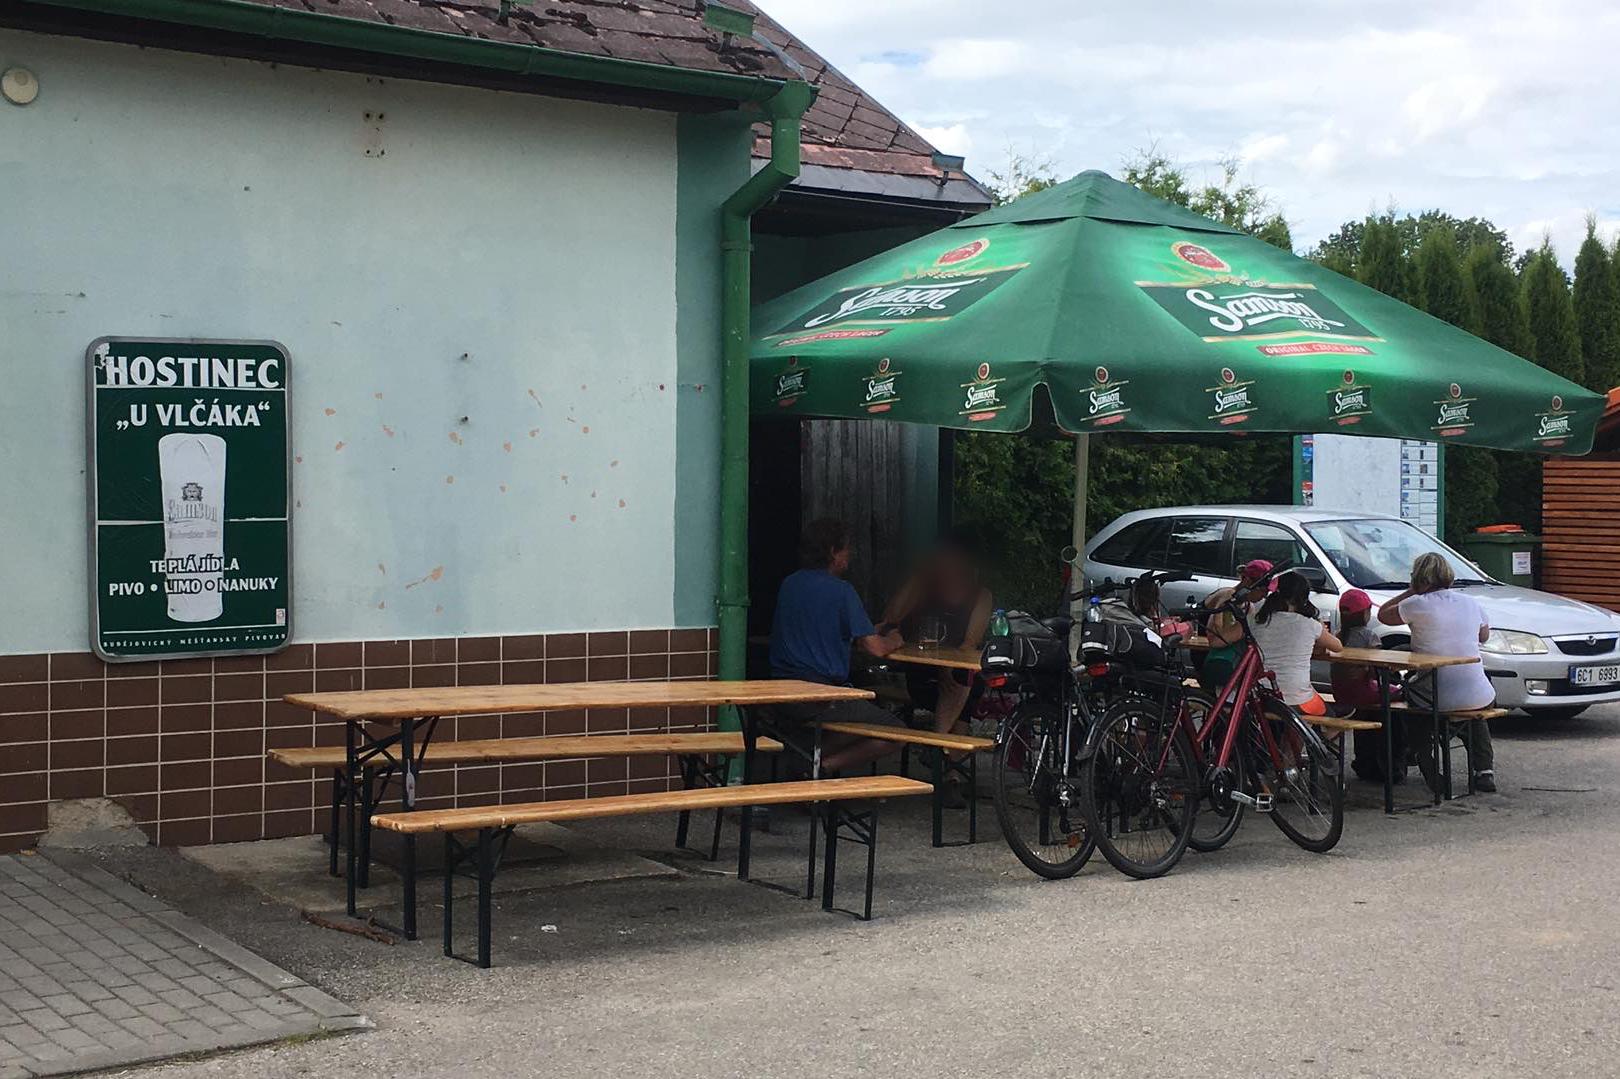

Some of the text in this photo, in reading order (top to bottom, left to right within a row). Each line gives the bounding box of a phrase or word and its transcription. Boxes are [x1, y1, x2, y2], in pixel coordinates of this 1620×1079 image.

[1186, 289, 1345, 332] Samson
[1299, 318, 1331, 331] 1795
[105, 356, 279, 388] HOSTINEC
[866, 378, 896, 401] Samson
[965, 384, 999, 409] Samson
[1089, 387, 1124, 414] Samson
[1215, 387, 1252, 413] Samson
[1335, 390, 1366, 414] Samson
[1438, 404, 1469, 425] Samson
[1538, 416, 1571, 437] Samson
[150, 554, 240, 573] TEPLÁ JÍDLA
[109, 577, 279, 596] PIVO LIMO NANUKY
[1577, 667, 1618, 681] 6C1 6993
